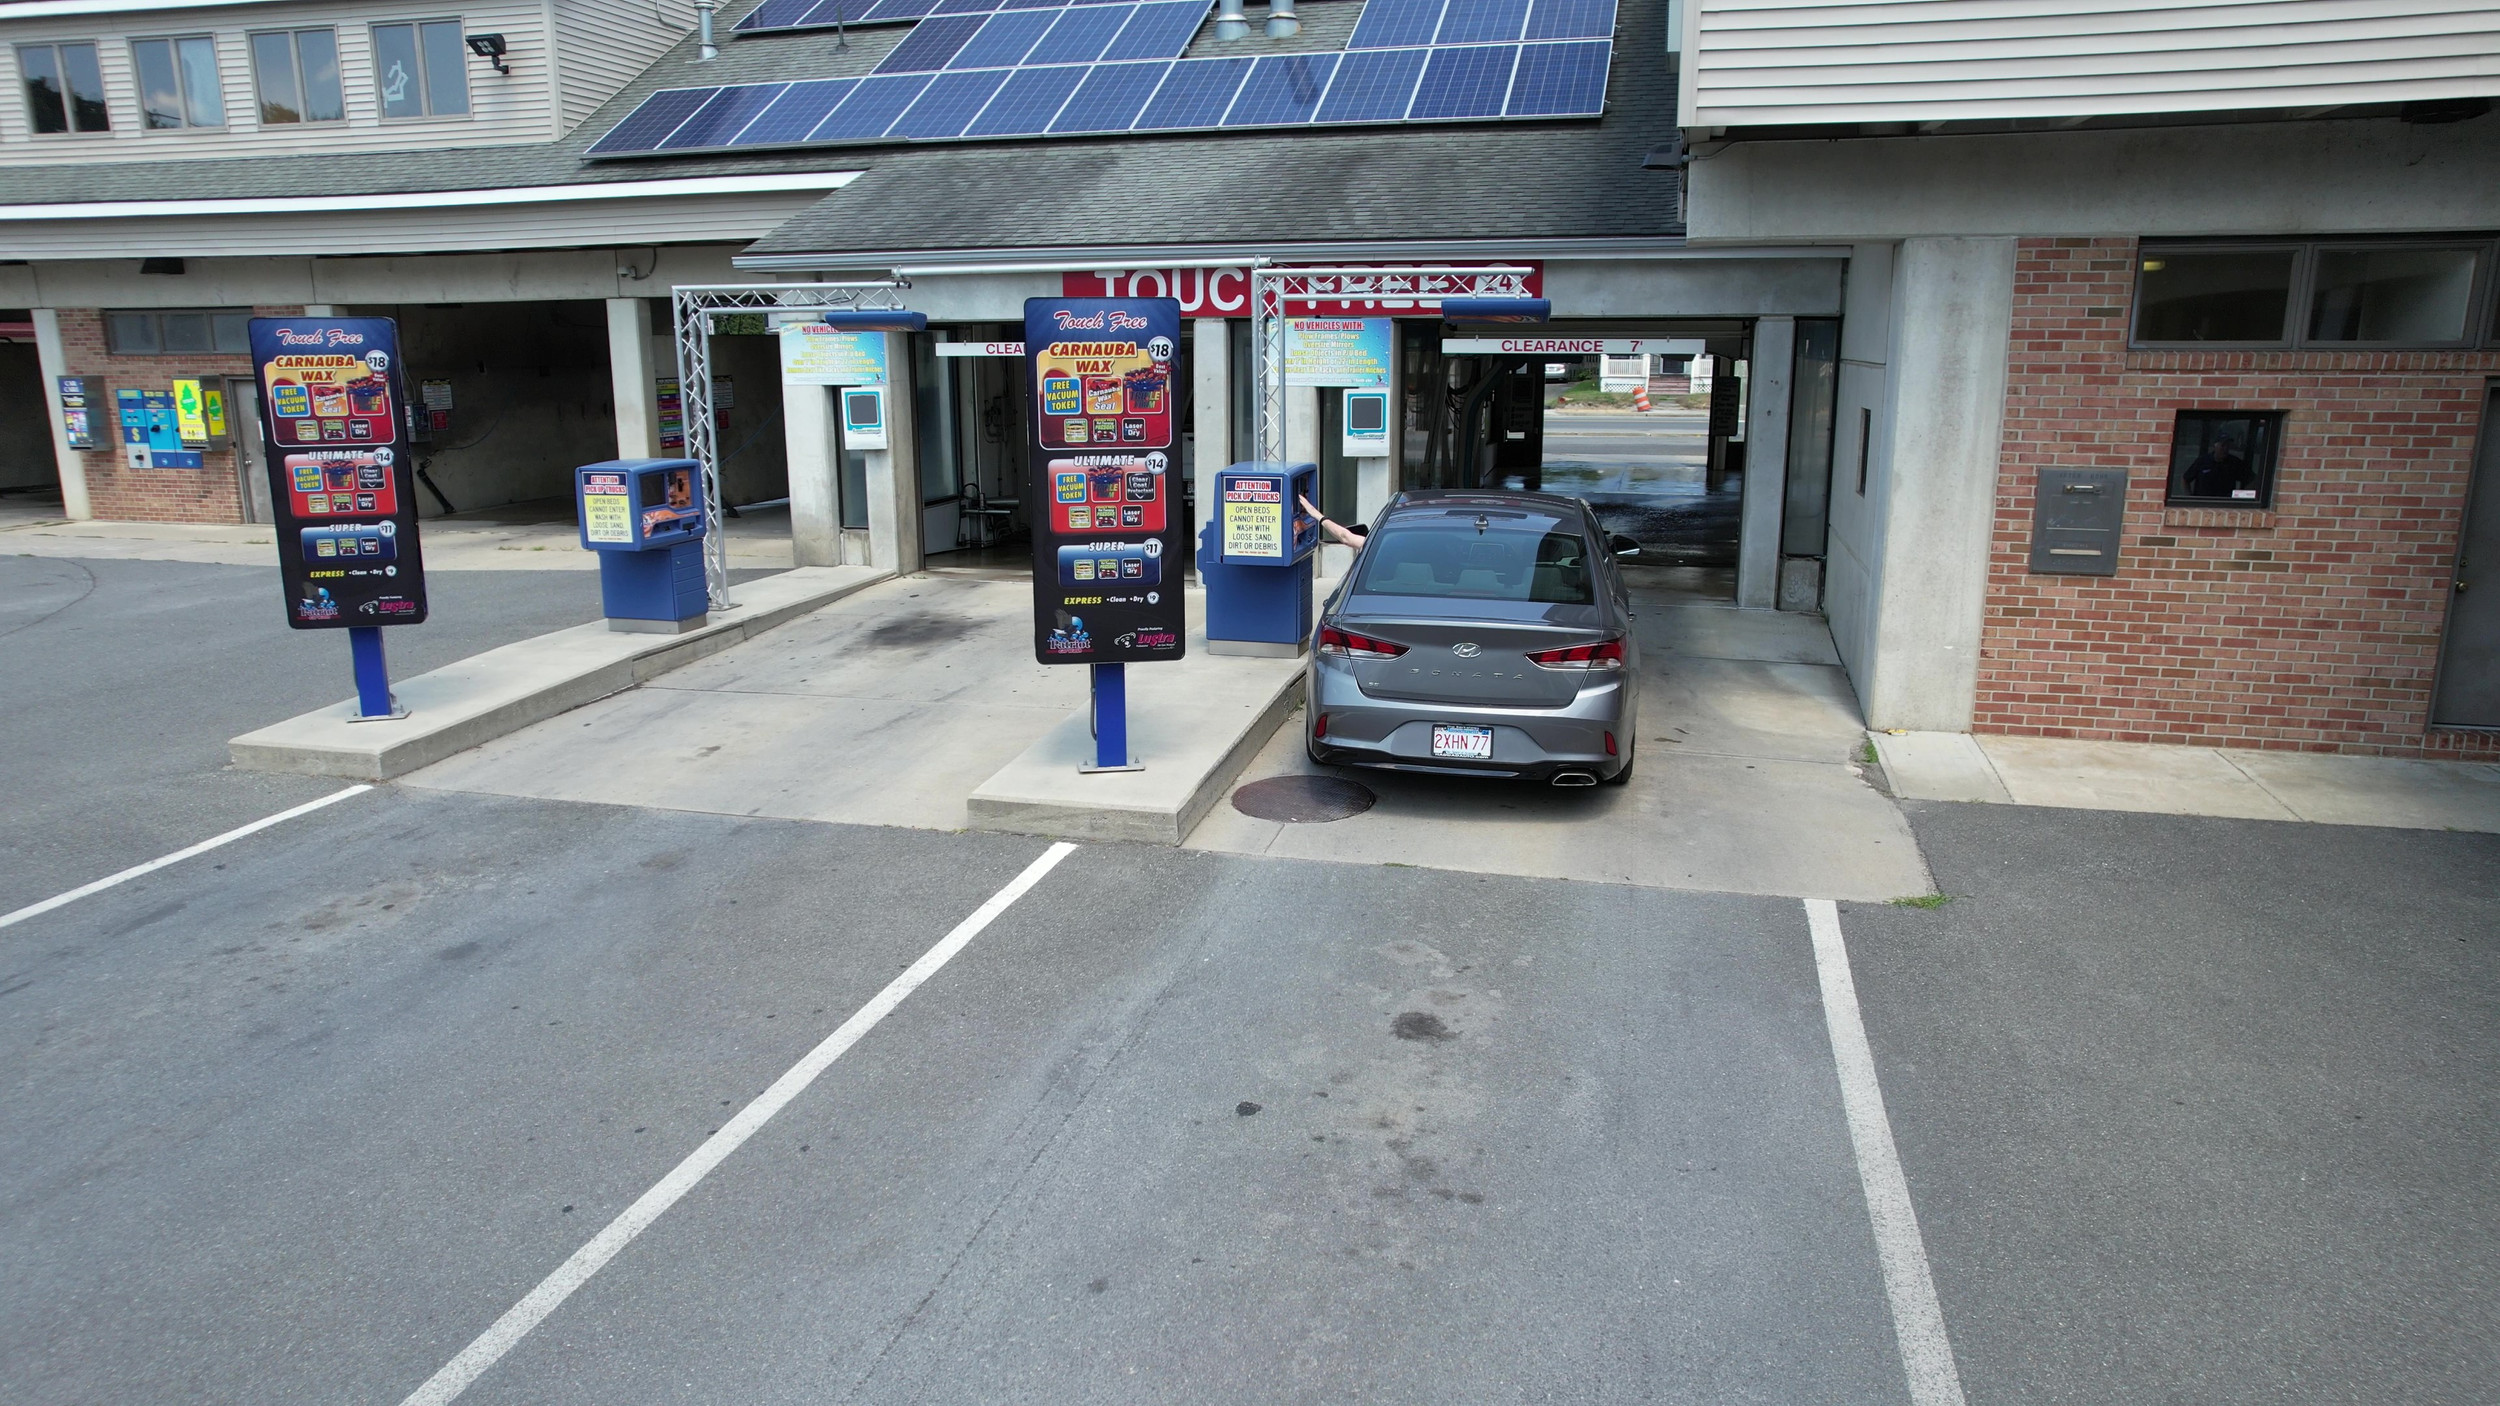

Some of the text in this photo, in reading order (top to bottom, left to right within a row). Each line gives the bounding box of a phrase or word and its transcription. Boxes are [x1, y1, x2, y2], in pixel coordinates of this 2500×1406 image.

[1053, 310, 1148, 332] Touch Free
[1294, 321, 1305, 330] NO
[1306, 321, 1340, 330] VEHICLES
[276, 329, 364, 347] Touch Free
[986, 343, 1025, 354] CLEA
[1049, 343, 1169, 357] CARNAUBA $18
[1501, 340, 1643, 352] CLEARANCE 7'
[1310, 349, 1334, 357] Objects
[274, 355, 386, 368] CARNAUBA $18
[1356, 358, 1378, 366] Length
[1075, 360, 1112, 373] WAX
[300, 370, 334, 382] WAX
[1052, 381, 1070, 390] FREE
[280, 388, 298, 396] FREE
[1046, 390, 1078, 401] VACUUM
[1088, 387, 1120, 397] Carnauba
[276, 396, 306, 405] VACUUM
[1051, 400, 1076, 410] TOKEN
[282, 405, 306, 413] TOKEN
[1094, 402, 1116, 410] Seal
[1127, 428, 1140, 437] Dry
[308, 451, 391, 462] ULTIMATE $14
[1073, 455, 1164, 469] ULTIMATE $14
[296, 475, 320, 483] VACUUM
[591, 476, 618, 484] ATTENTION
[1062, 475, 1077, 483] FREE
[585, 485, 597, 494] PICK
[598, 485, 605, 493] UP
[1058, 483, 1084, 492] VACUUM
[1236, 481, 1270, 490] ATTENTION
[1062, 491, 1083, 499] TOKEN
[1227, 492, 1280, 501] PICK UP TRUCKS
[1235, 506, 1271, 514] OPEN BEDS
[1230, 515, 1276, 523] CANNOT ENTER
[329, 524, 392, 534] SUPER $11
[1236, 524, 1253, 532] WASH
[1232, 533, 1252, 541] LOOSE
[1088, 542, 1158, 554] SUPER $11
[1244, 542, 1253, 550] OR
[1254, 543, 1278, 551] DEBRIS
[310, 570, 345, 578] EXPRESS
[1126, 567, 1138, 575] Dry
[1064, 596, 1102, 605] EXPRESS
[1409, 667, 1523, 680] SONATA
[1434, 733, 1489, 751] 2XHN 77
